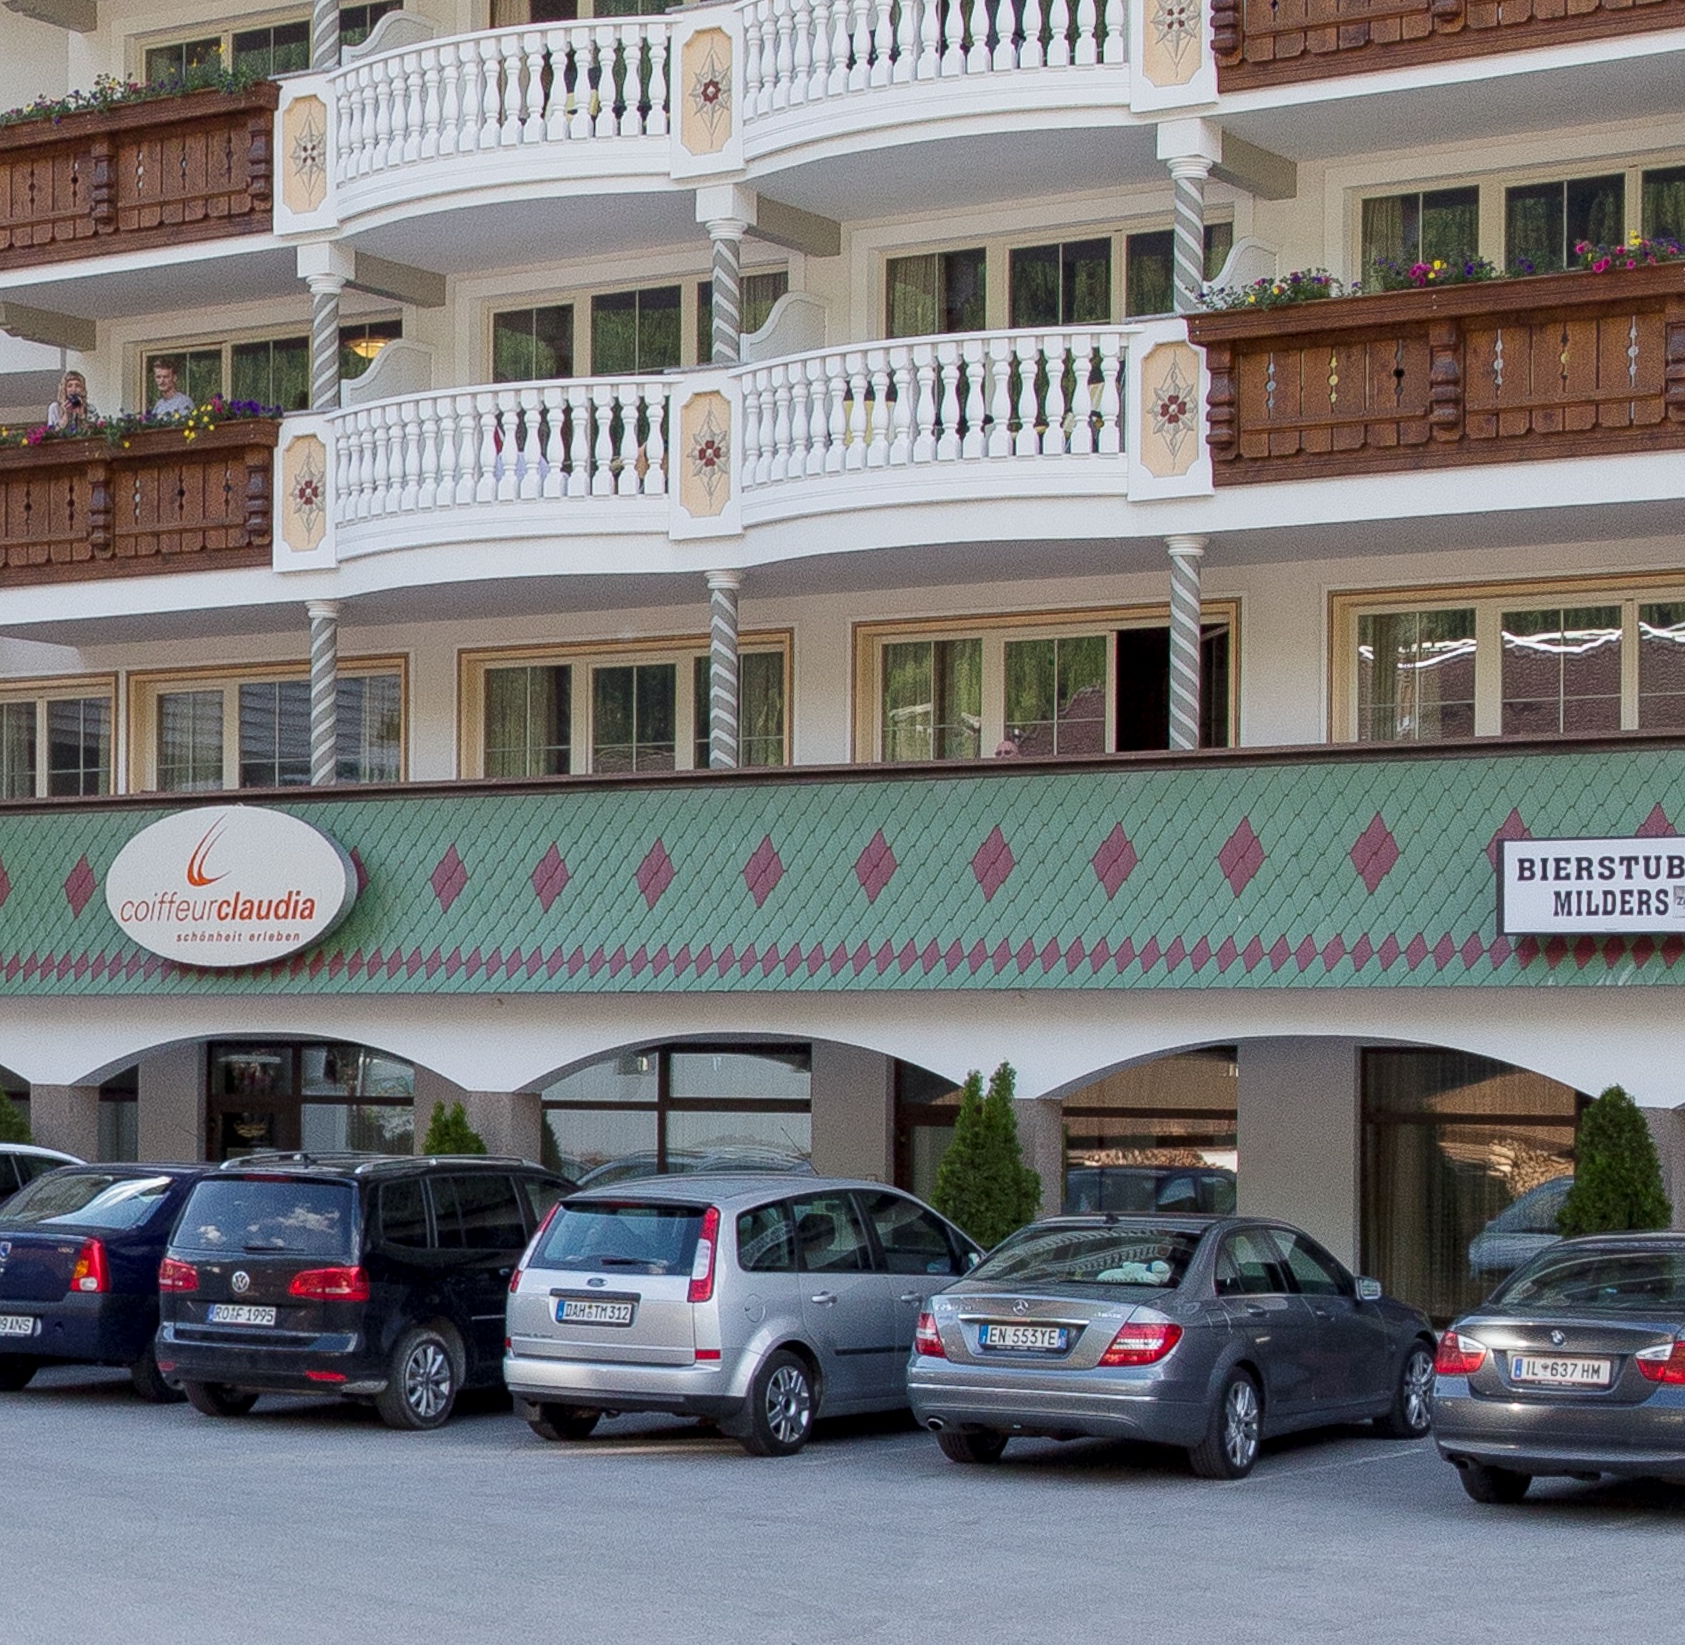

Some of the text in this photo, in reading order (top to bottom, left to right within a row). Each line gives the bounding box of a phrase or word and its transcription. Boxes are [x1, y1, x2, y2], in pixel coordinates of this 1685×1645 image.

[1552, 888, 1670, 918] MILDERS
[175, 929, 301, 943] schönheit erleben
[989, 1326, 1007, 1343] EN
[1526, 1360, 1602, 1380] IL 637 HM
